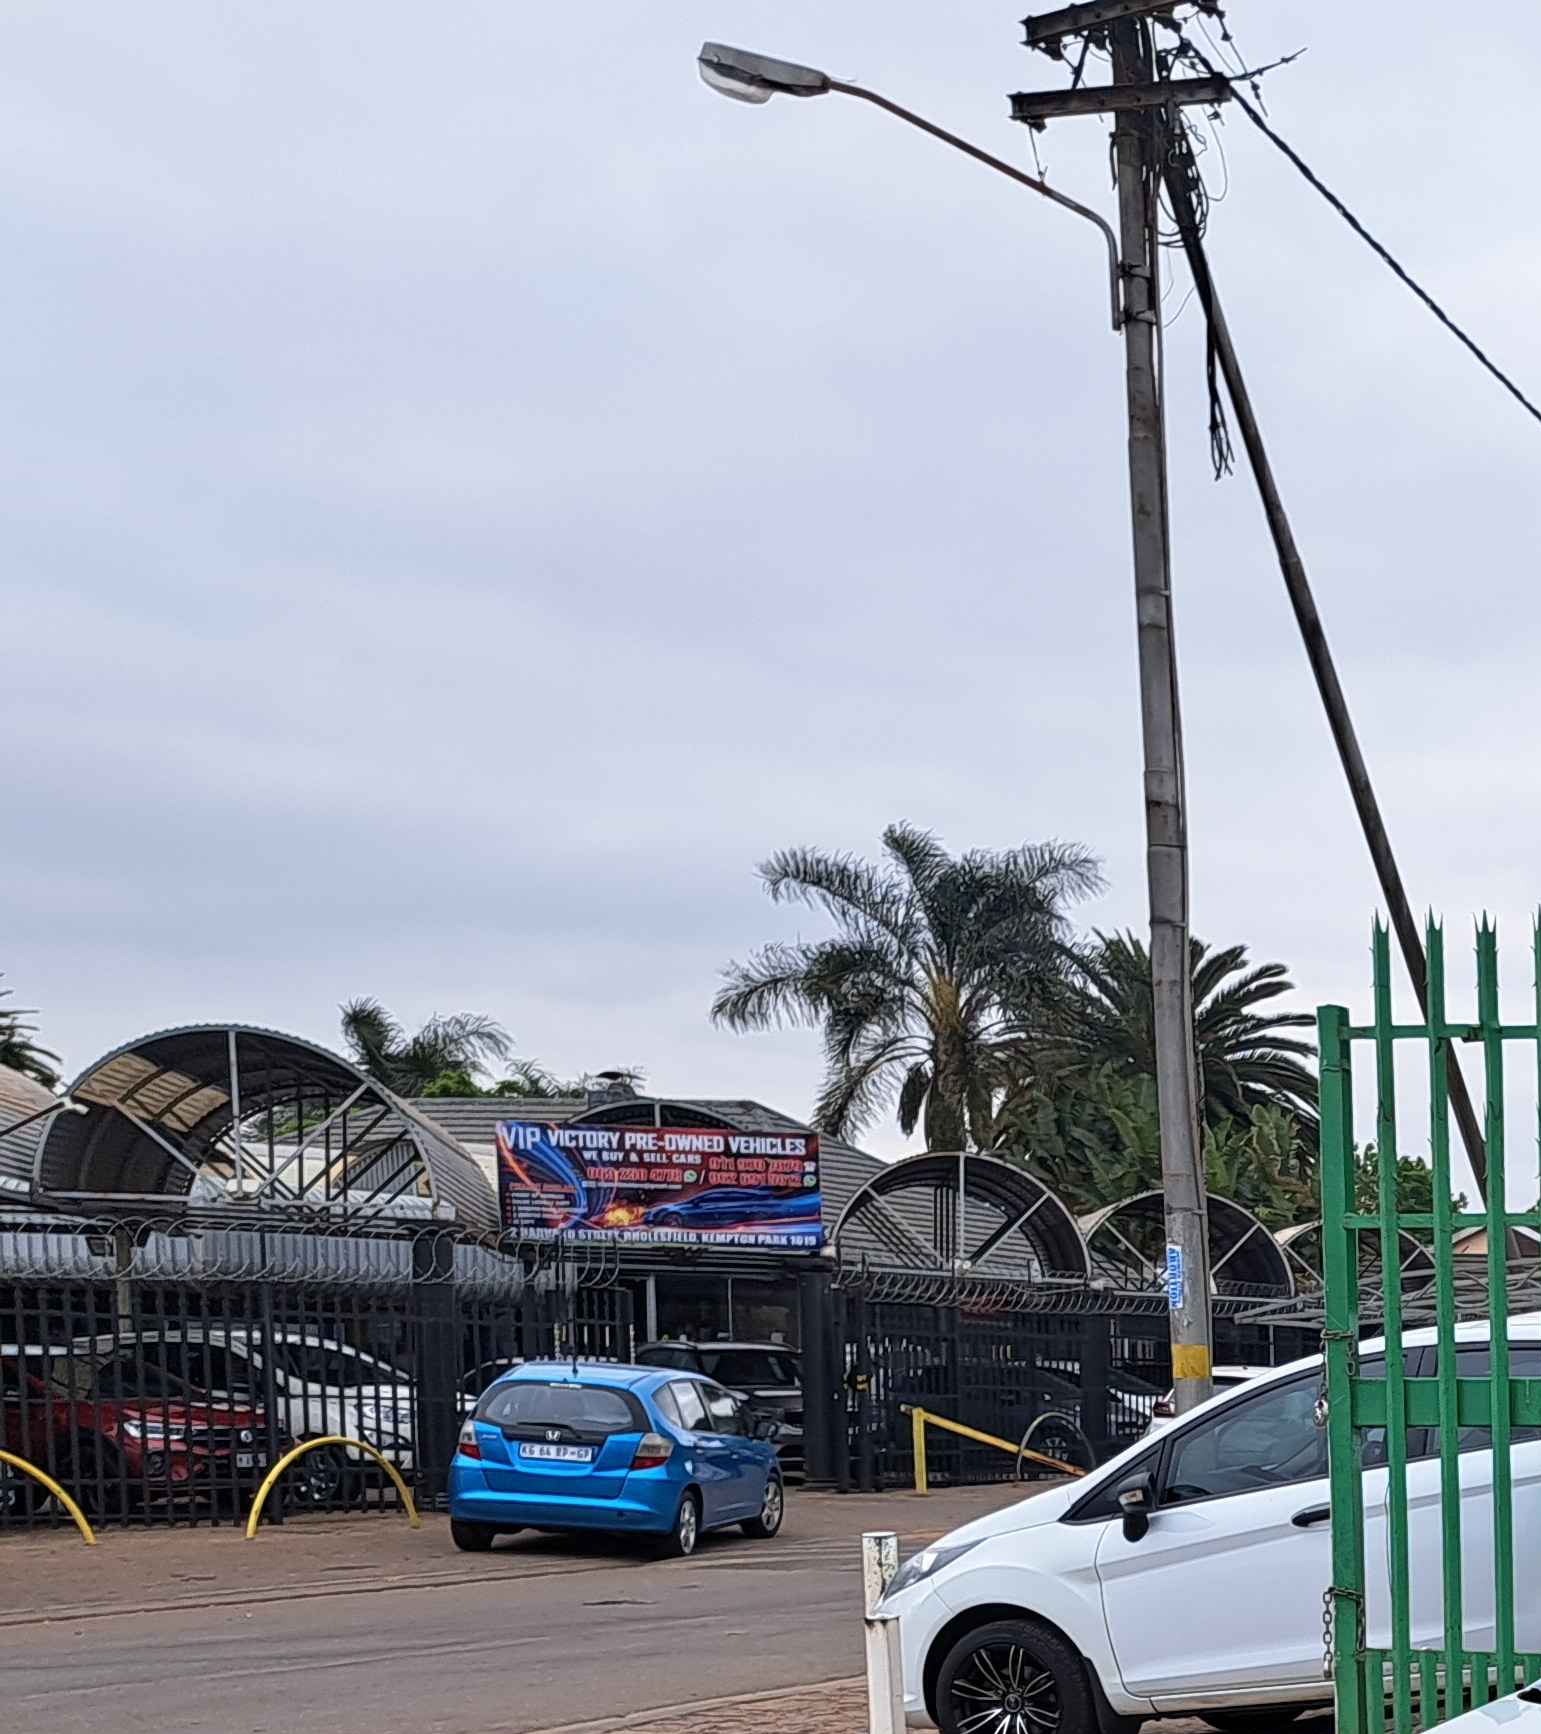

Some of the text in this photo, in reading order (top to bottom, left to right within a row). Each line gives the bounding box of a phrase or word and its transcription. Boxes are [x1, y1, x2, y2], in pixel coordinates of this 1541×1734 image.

[502, 1126, 806, 1155] VIP VICTORY PRE-OWNED VEHICLES
[583, 1151, 599, 1161] WE
[602, 1152, 624, 1162] BUY
[643, 1152, 669, 1163] SELL
[672, 1153, 702, 1165] CARS
[702, 1233, 756, 1245] KEMPTON
[758, 1234, 787, 1245] PARK
